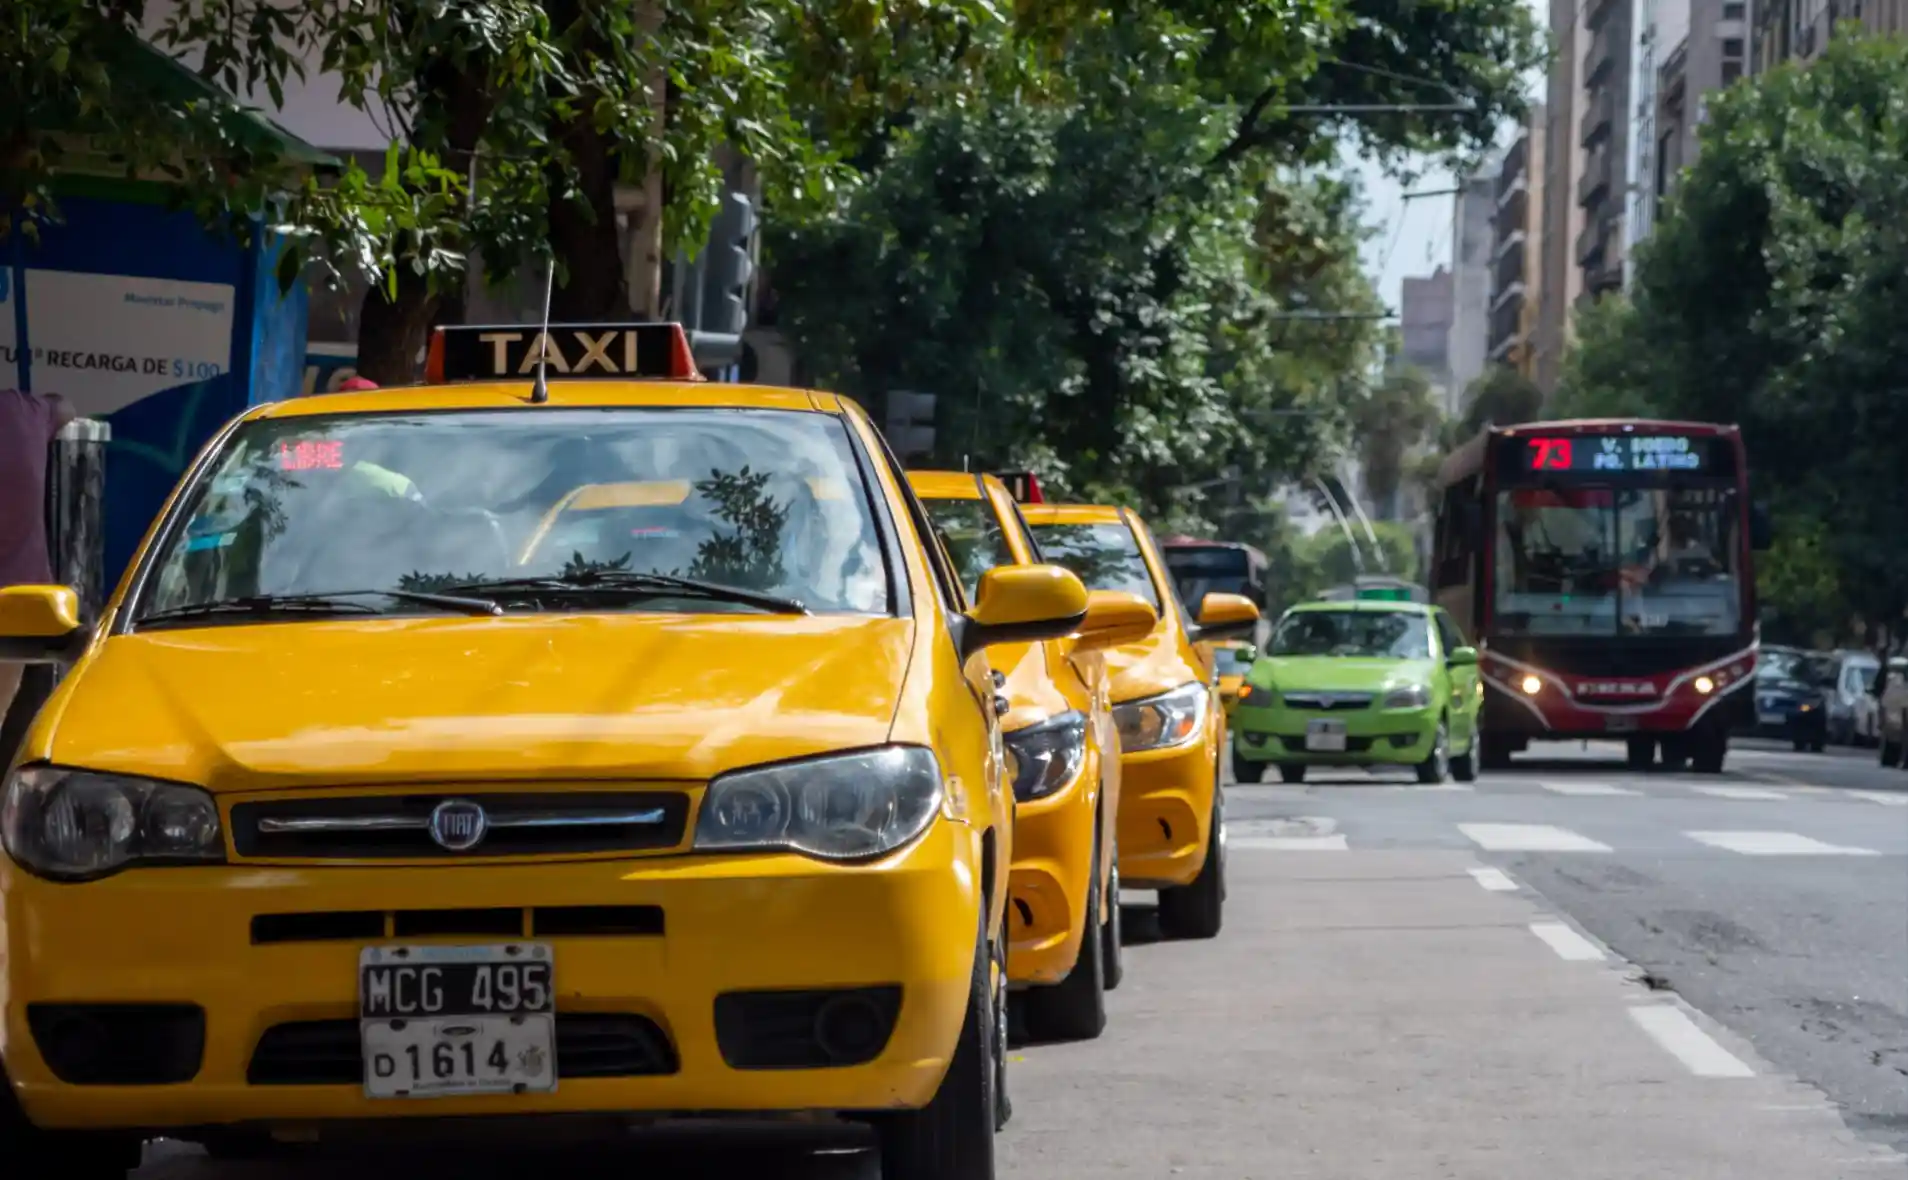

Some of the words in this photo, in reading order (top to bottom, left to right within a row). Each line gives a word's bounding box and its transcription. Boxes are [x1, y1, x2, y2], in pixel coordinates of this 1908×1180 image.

[47, 349, 138, 373] RECARGA
[143, 357, 167, 375] DE
[479, 330, 638, 374] TAXI
[280, 439, 345, 471] LIBRE
[1528, 437, 1573, 469] 73
[443, 813, 475, 836] FIAT
[369, 967, 444, 1013] MCG
[472, 964, 547, 1011] 495
[405, 1039, 508, 1081] 1614
